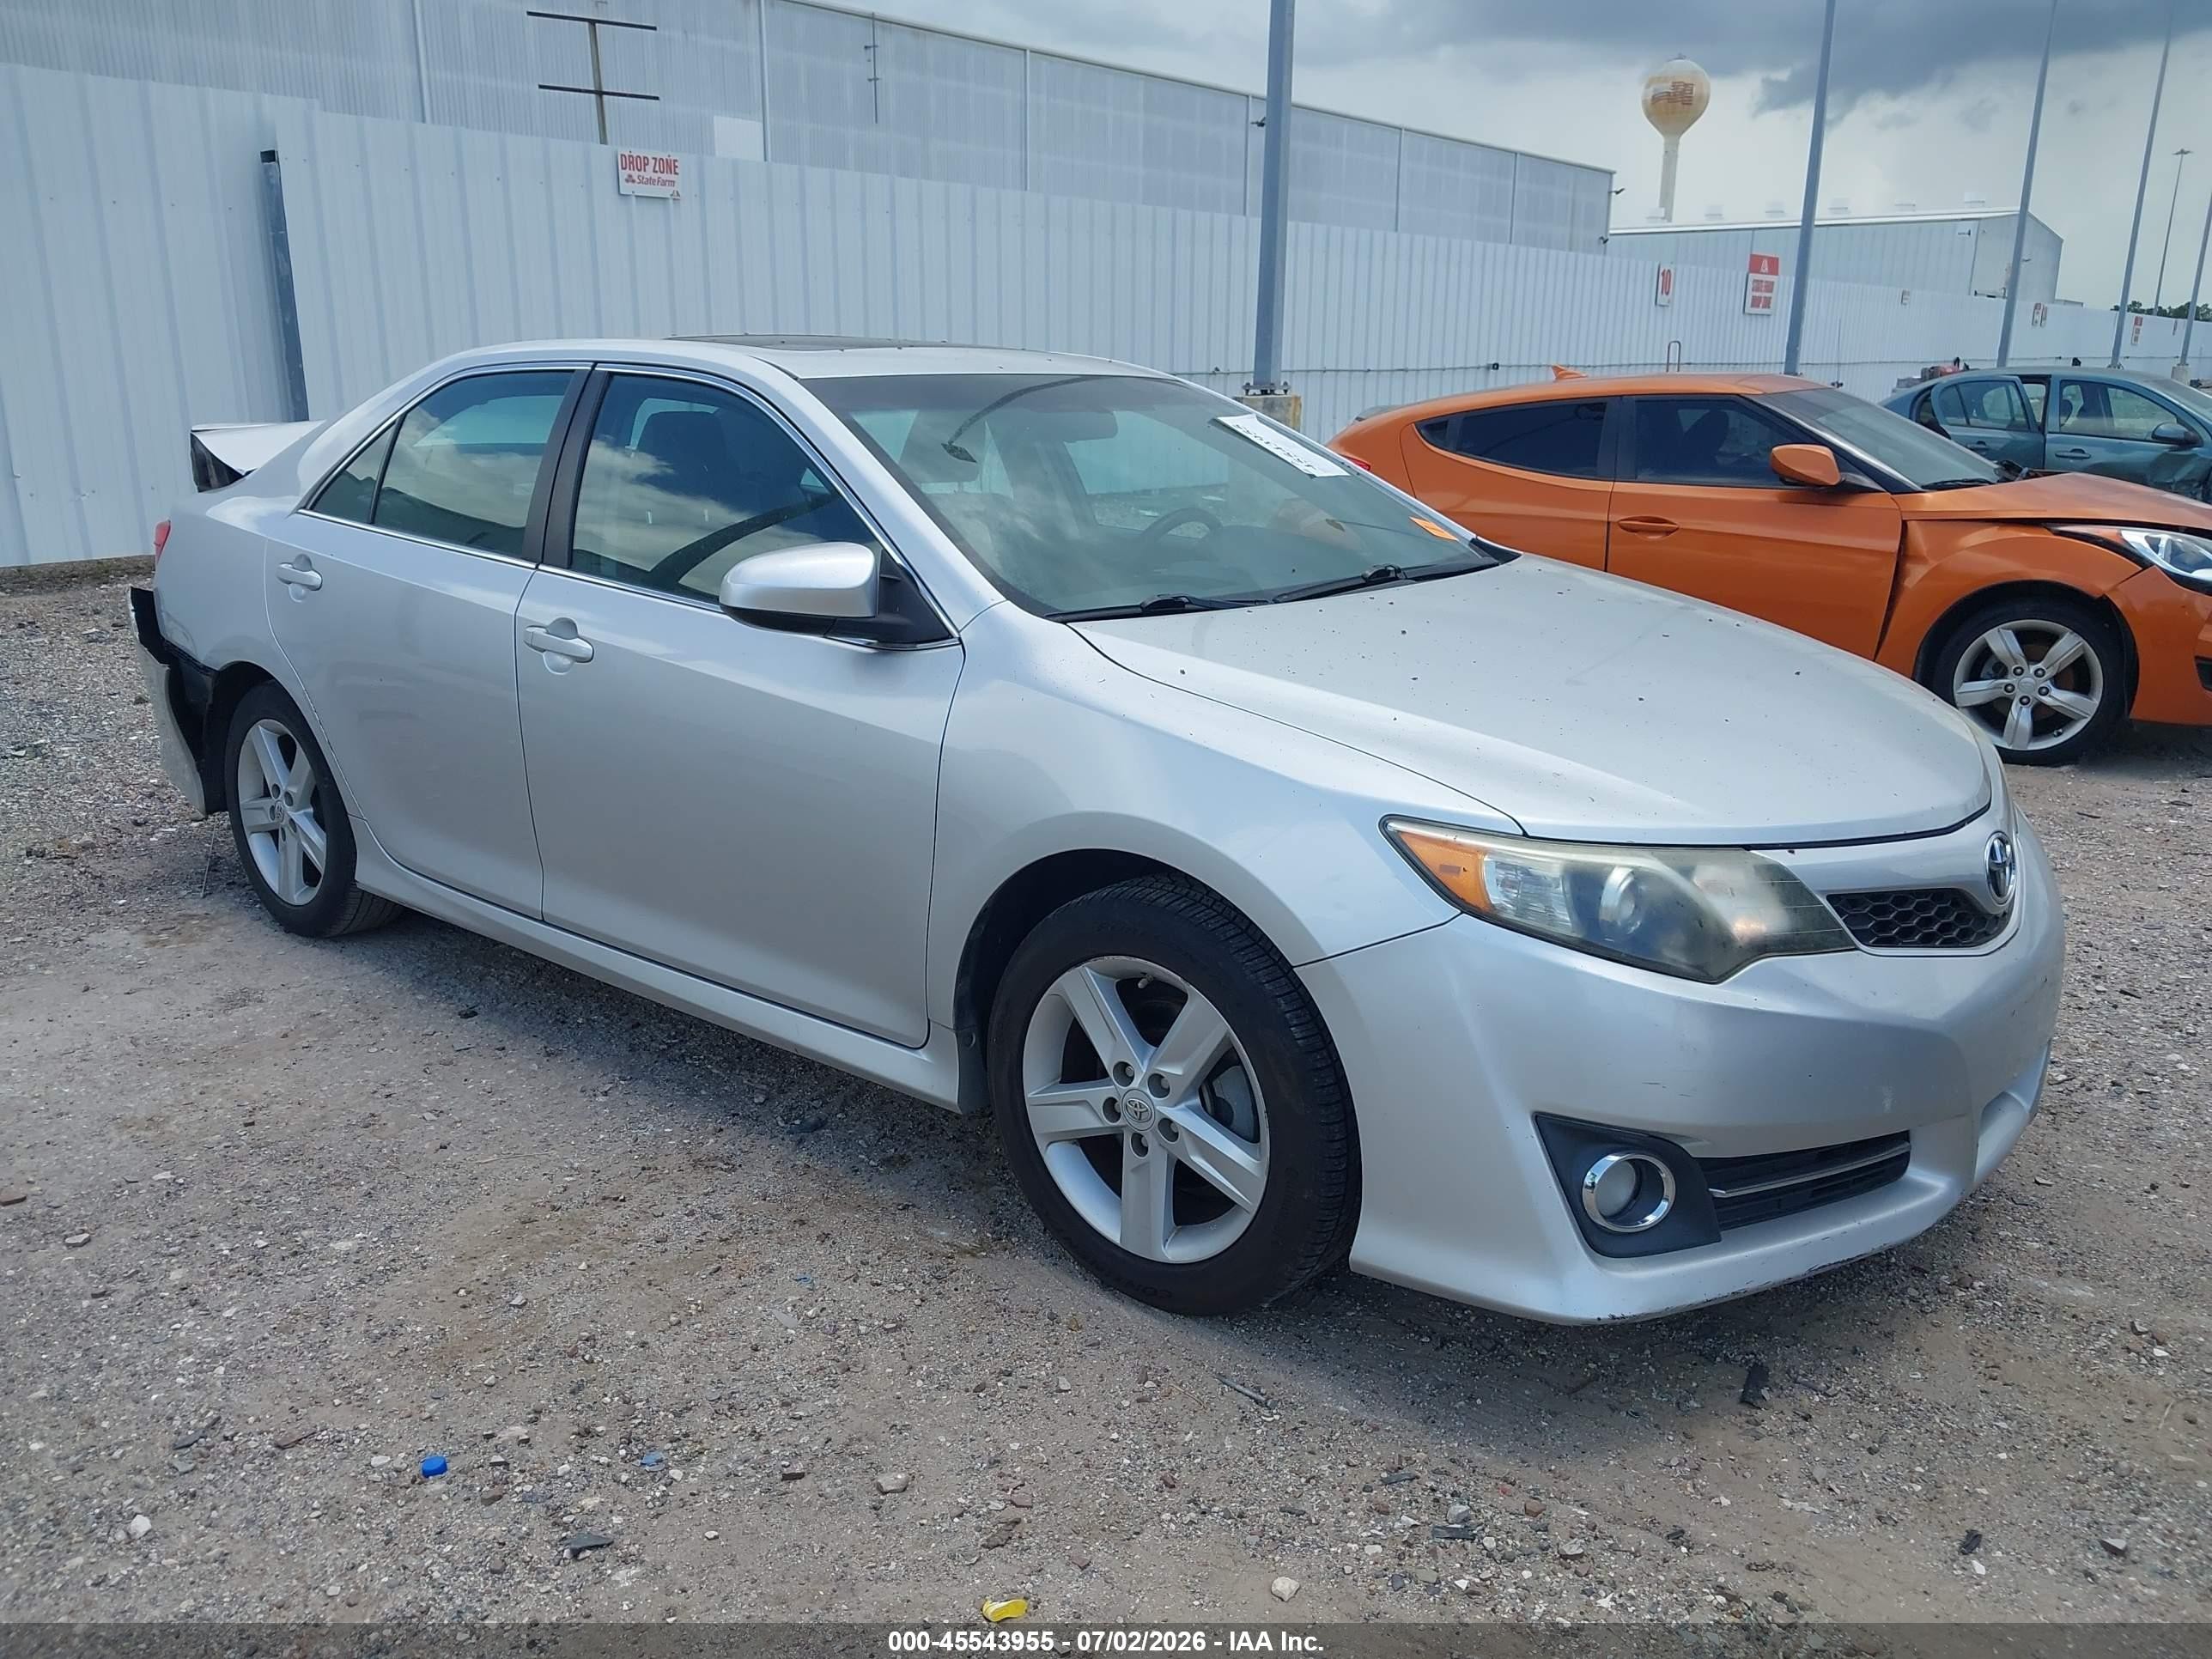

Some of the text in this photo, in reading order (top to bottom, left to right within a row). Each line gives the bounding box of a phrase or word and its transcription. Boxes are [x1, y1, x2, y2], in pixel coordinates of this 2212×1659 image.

[620, 154, 679, 175] DROP ZONE
[1661, 269, 1672, 296] 10
